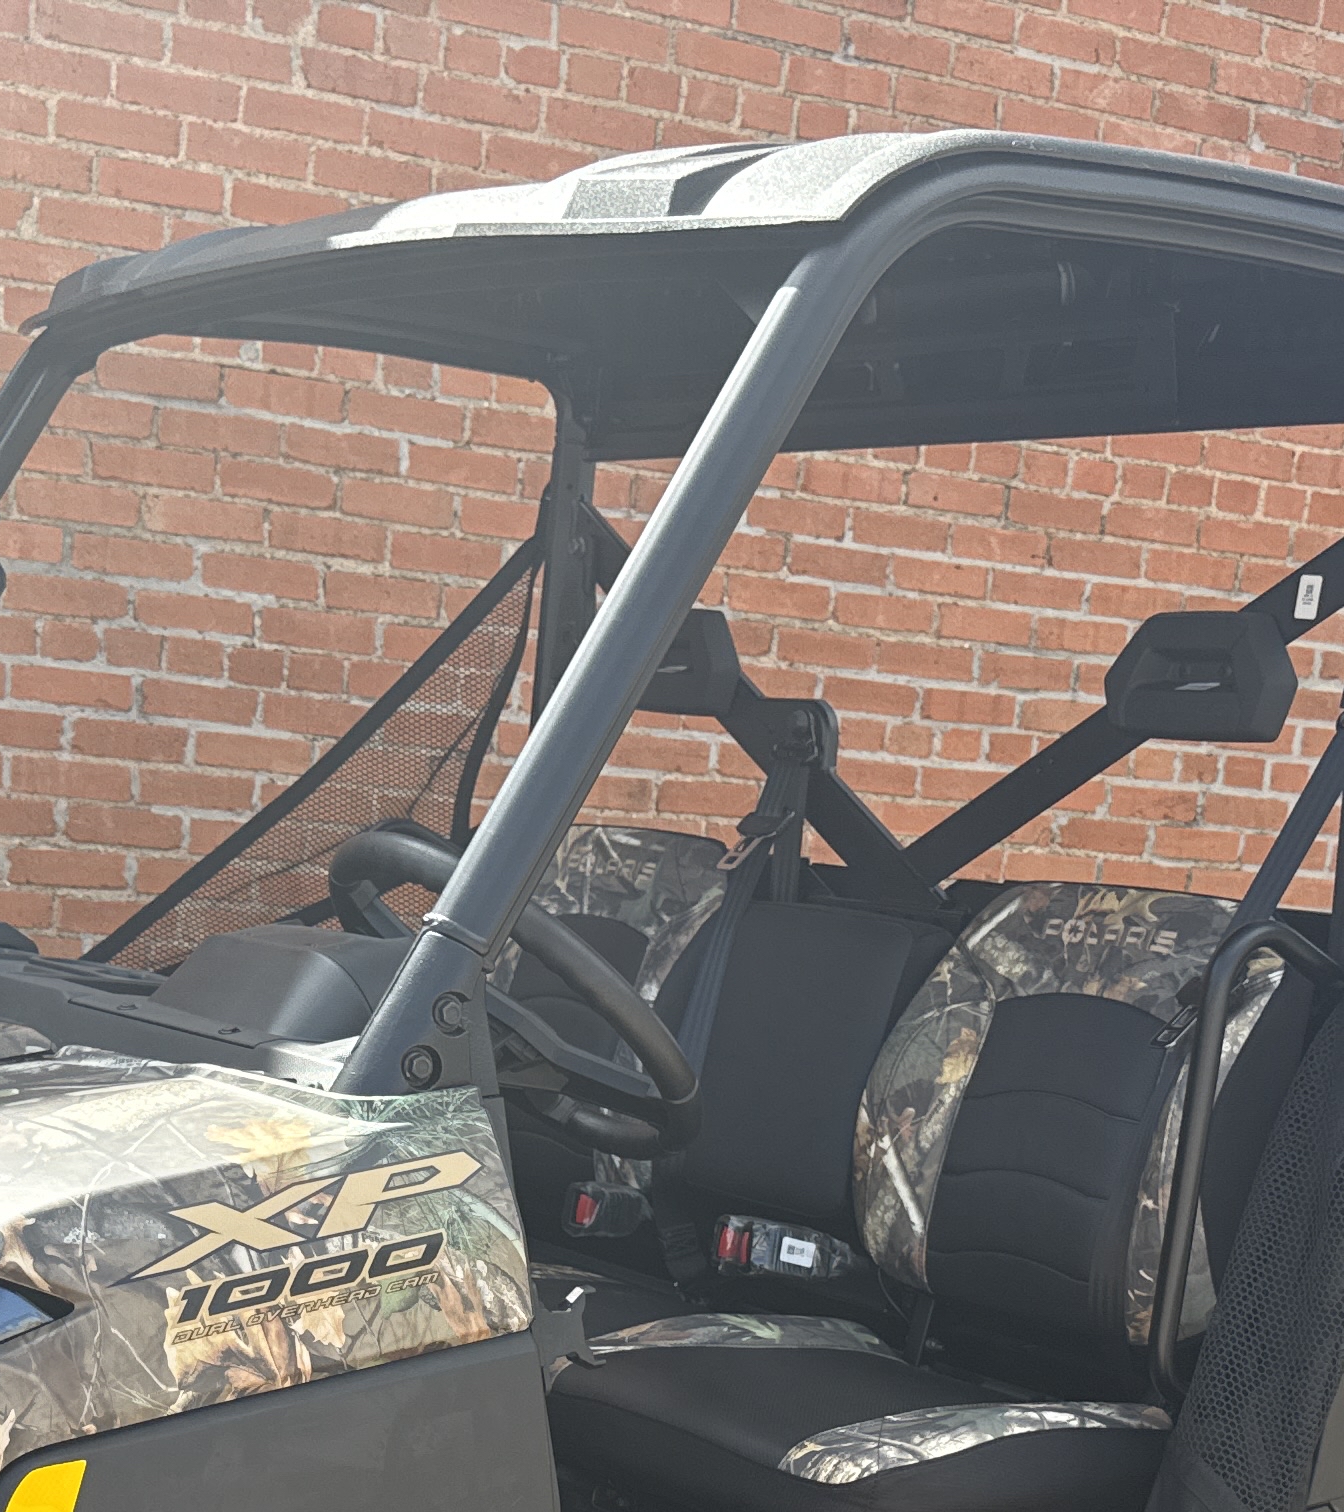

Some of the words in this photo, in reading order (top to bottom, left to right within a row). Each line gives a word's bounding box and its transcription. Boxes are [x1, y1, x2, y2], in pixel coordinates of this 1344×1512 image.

[567, 851, 658, 888] POLARIS
[1043, 917, 1179, 956] POLARIS
[109, 1148, 486, 1289] XP
[171, 1318, 242, 1346] DUAL
[247, 1284, 383, 1327] OVERHEAD
[386, 1271, 439, 1294] CAM
[173, 1227, 447, 1328] 1000
